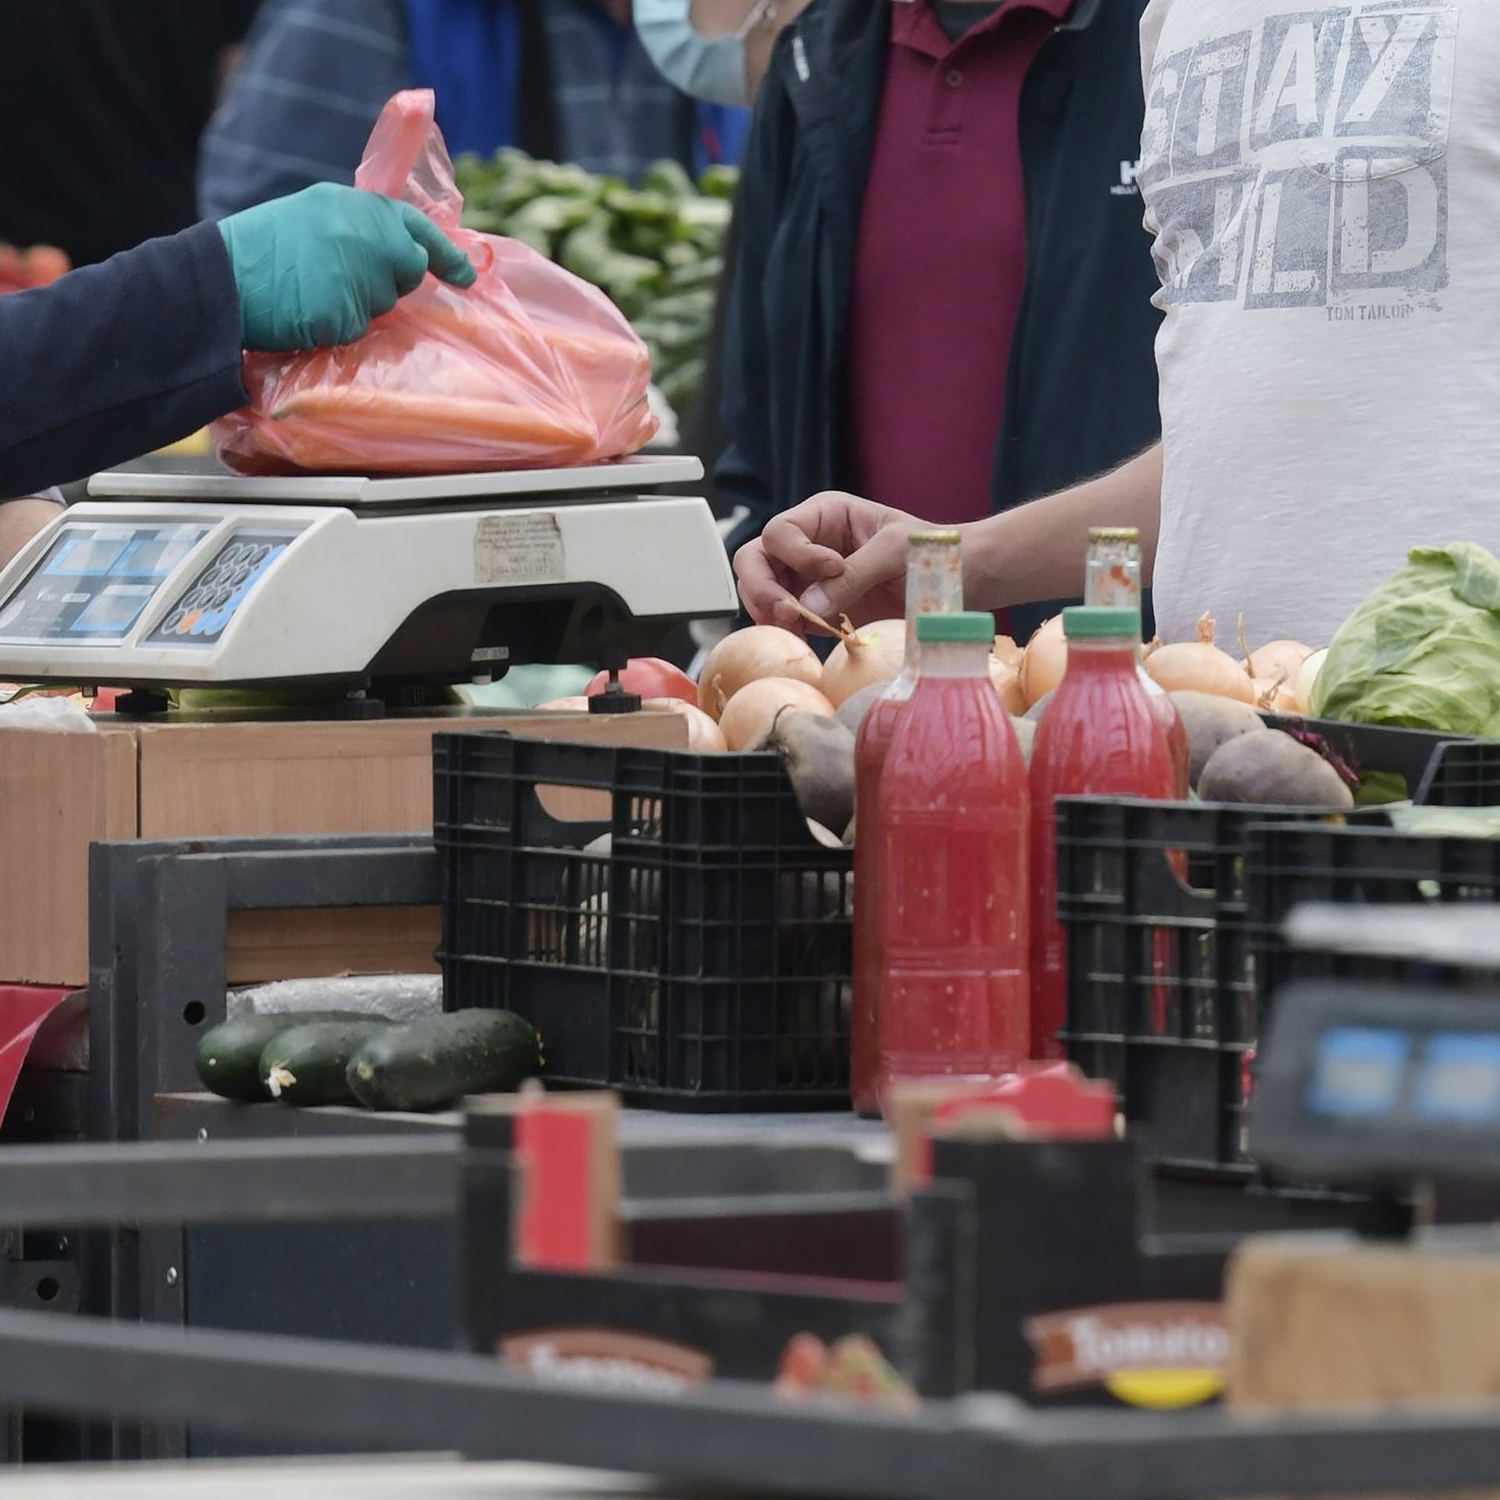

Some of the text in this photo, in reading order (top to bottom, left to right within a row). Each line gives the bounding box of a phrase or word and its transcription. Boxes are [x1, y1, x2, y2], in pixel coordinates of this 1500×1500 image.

[1152, 152, 1445, 295] ILD
[1326, 303, 1411, 321] TOM TAILOR
